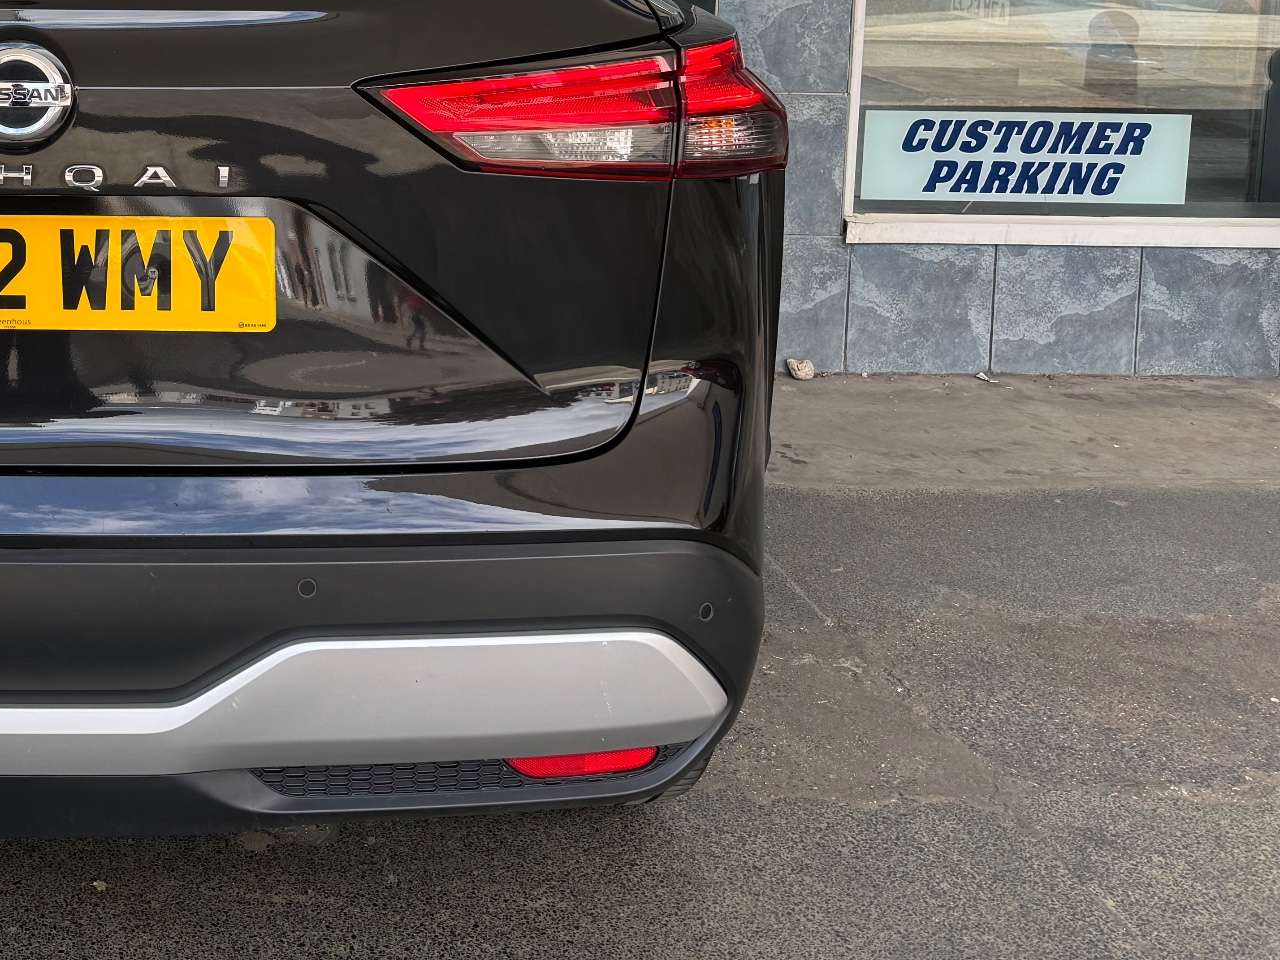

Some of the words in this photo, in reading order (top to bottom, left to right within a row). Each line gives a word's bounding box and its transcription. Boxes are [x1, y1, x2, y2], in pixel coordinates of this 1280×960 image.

[901, 118, 1152, 156] CUSTOMER
[921, 159, 1126, 196] PARKING
[59, 228, 235, 313] WMY
